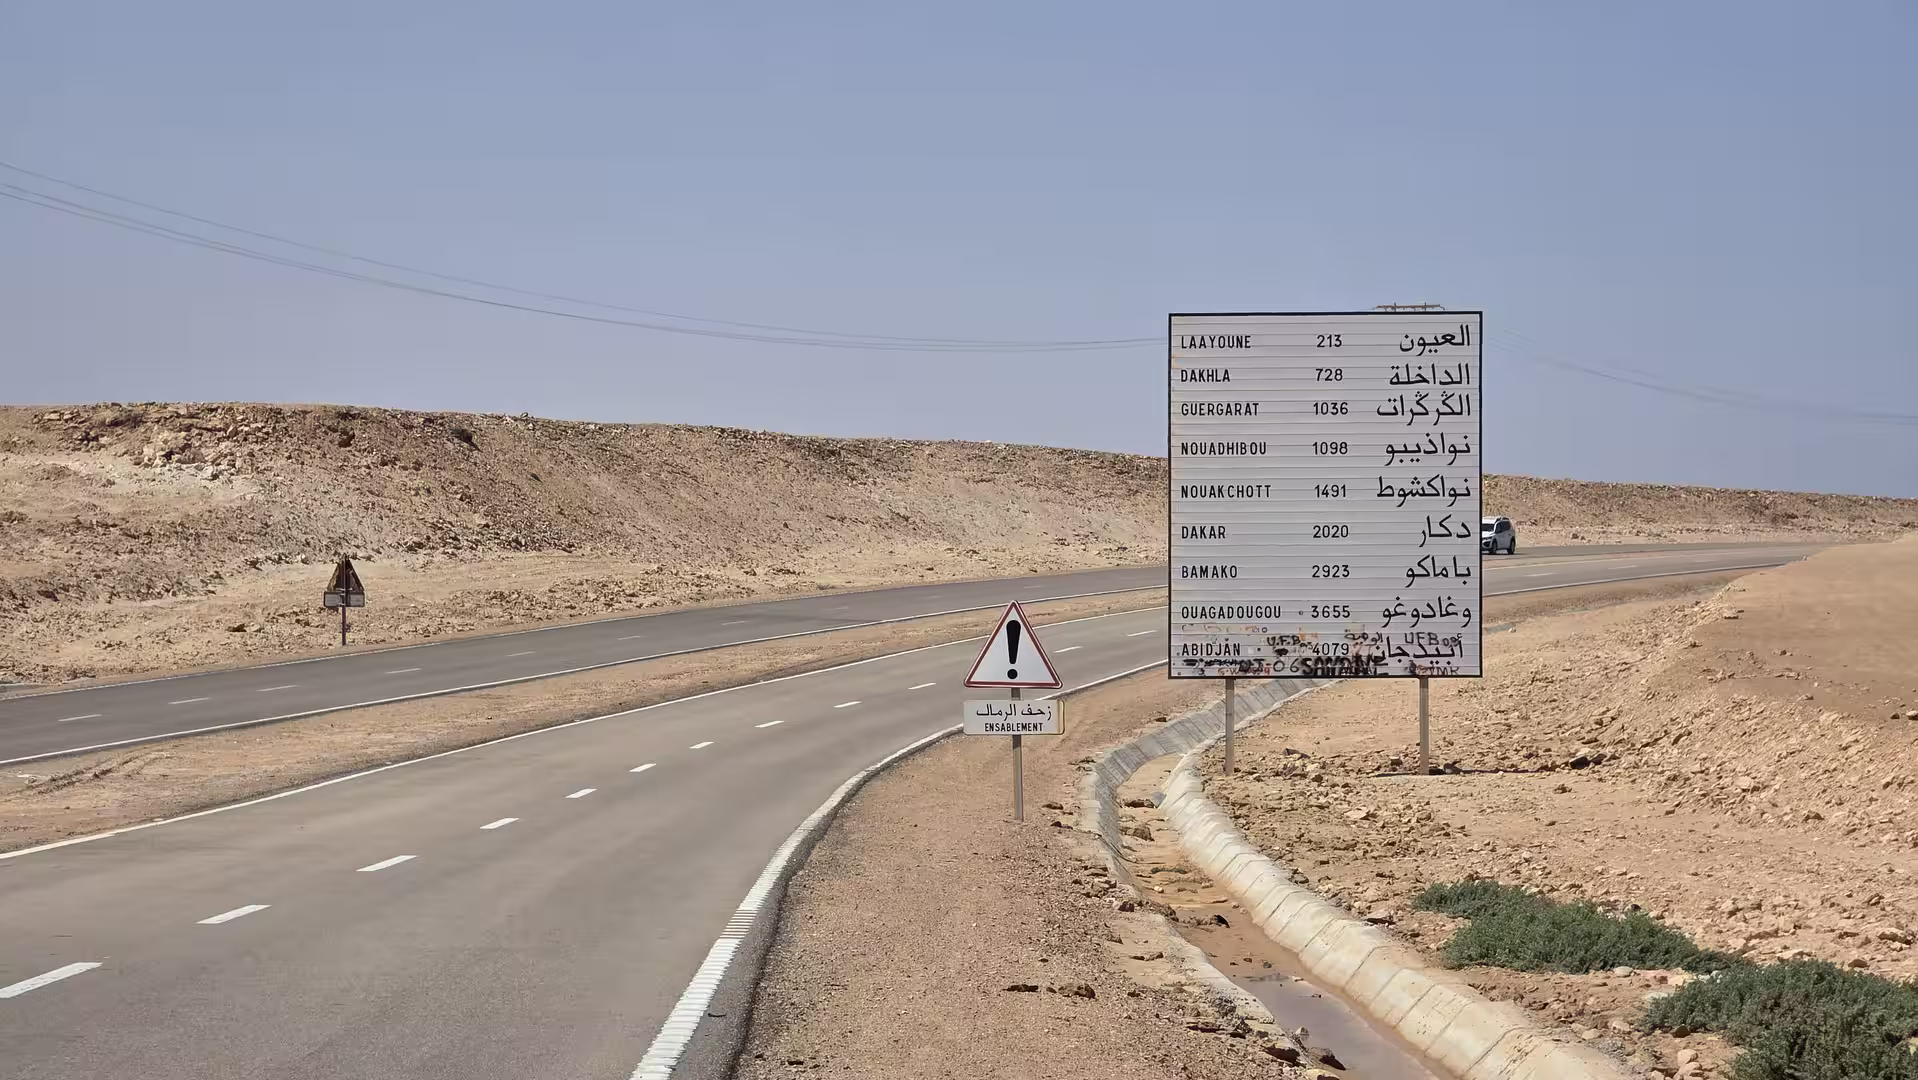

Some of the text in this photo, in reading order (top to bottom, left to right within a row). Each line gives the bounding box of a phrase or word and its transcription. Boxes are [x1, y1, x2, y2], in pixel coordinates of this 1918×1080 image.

[1181, 334, 1343, 349] LAAYOUNE 213
[1399, 324, 1471, 357] العيون
[1180, 368, 1343, 383] DAKHLA 728
[1389, 362, 1470, 386] الداخلة
[1181, 401, 1349, 417] GUERGARAT 1036
[1181, 441, 1348, 456] NOUADHIBOU 1098
[1384, 431, 1471, 467] نواذيبو
[1181, 484, 1346, 499] NOUAKCHOTT 1491
[1376, 473, 1471, 508] نواكشوط
[1181, 524, 1349, 540] DAKAR 2020
[1418, 513, 1472, 548] دكار
[1181, 564, 1350, 579] BAMAKO 2923
[1405, 554, 1472, 588] باماكو
[1181, 604, 1351, 620] OUAGADOUGOU 3655
[1381, 595, 1472, 628] وغادوغو
[1181, 643, 1241, 656] ABIDJAN
[1311, 642, 1350, 656] 4079
[976, 703, 1052, 721] زحف الرمال
[984, 722, 1043, 732] ENSABLEMENT
